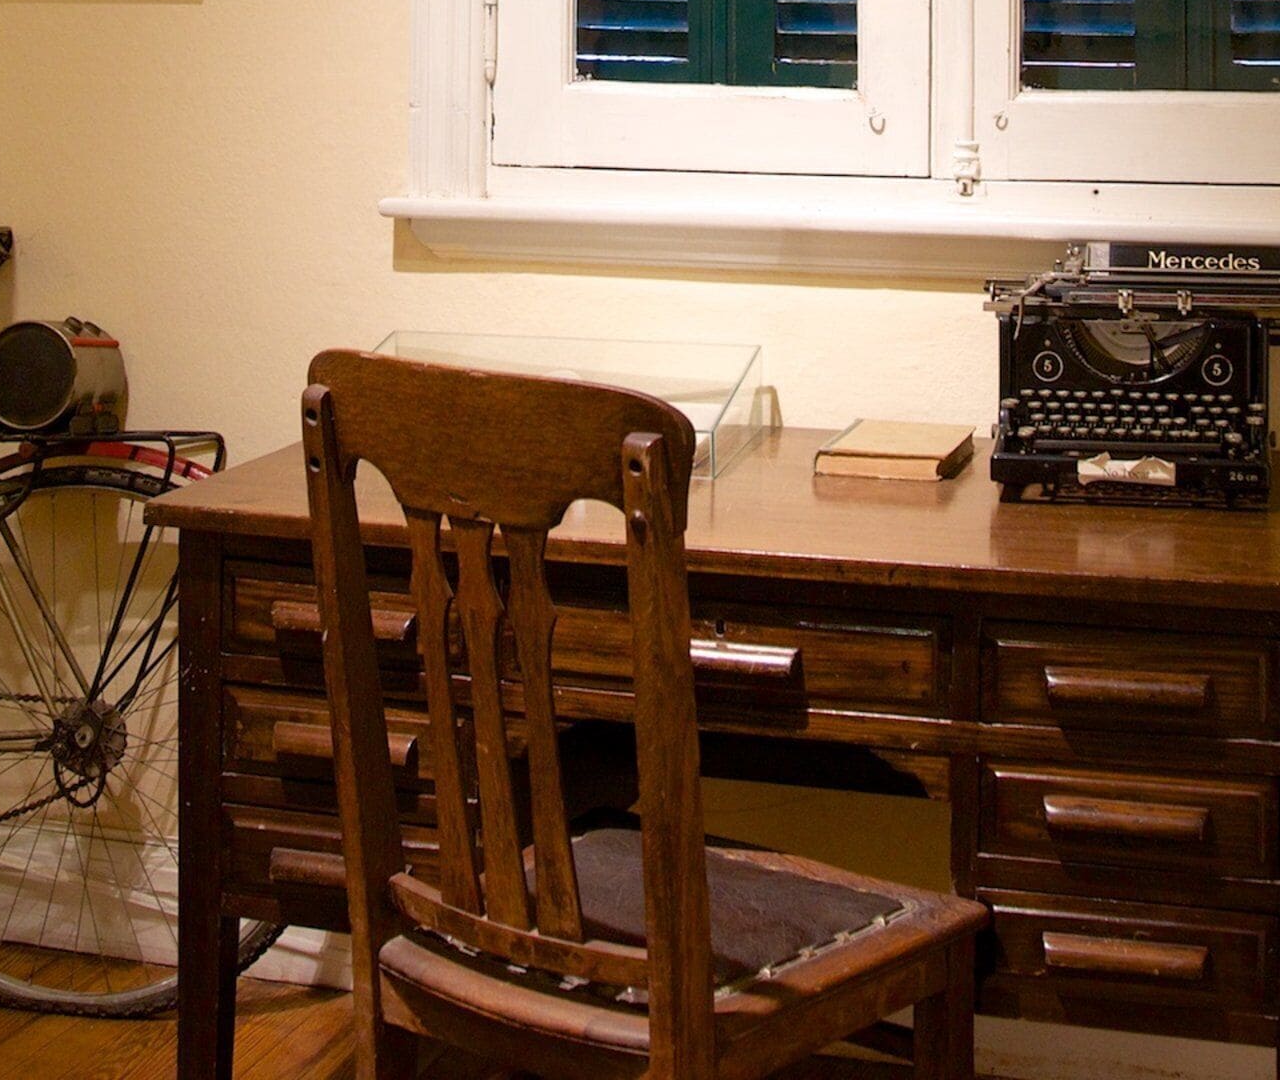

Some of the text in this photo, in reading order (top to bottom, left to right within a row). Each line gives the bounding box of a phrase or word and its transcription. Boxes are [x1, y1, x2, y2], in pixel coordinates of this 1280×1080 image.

[1148, 250, 1261, 270] Mercedes
[1044, 359, 1053, 373] 5
[1213, 363, 1222, 377] 5
[1229, 472, 1244, 481] 26
